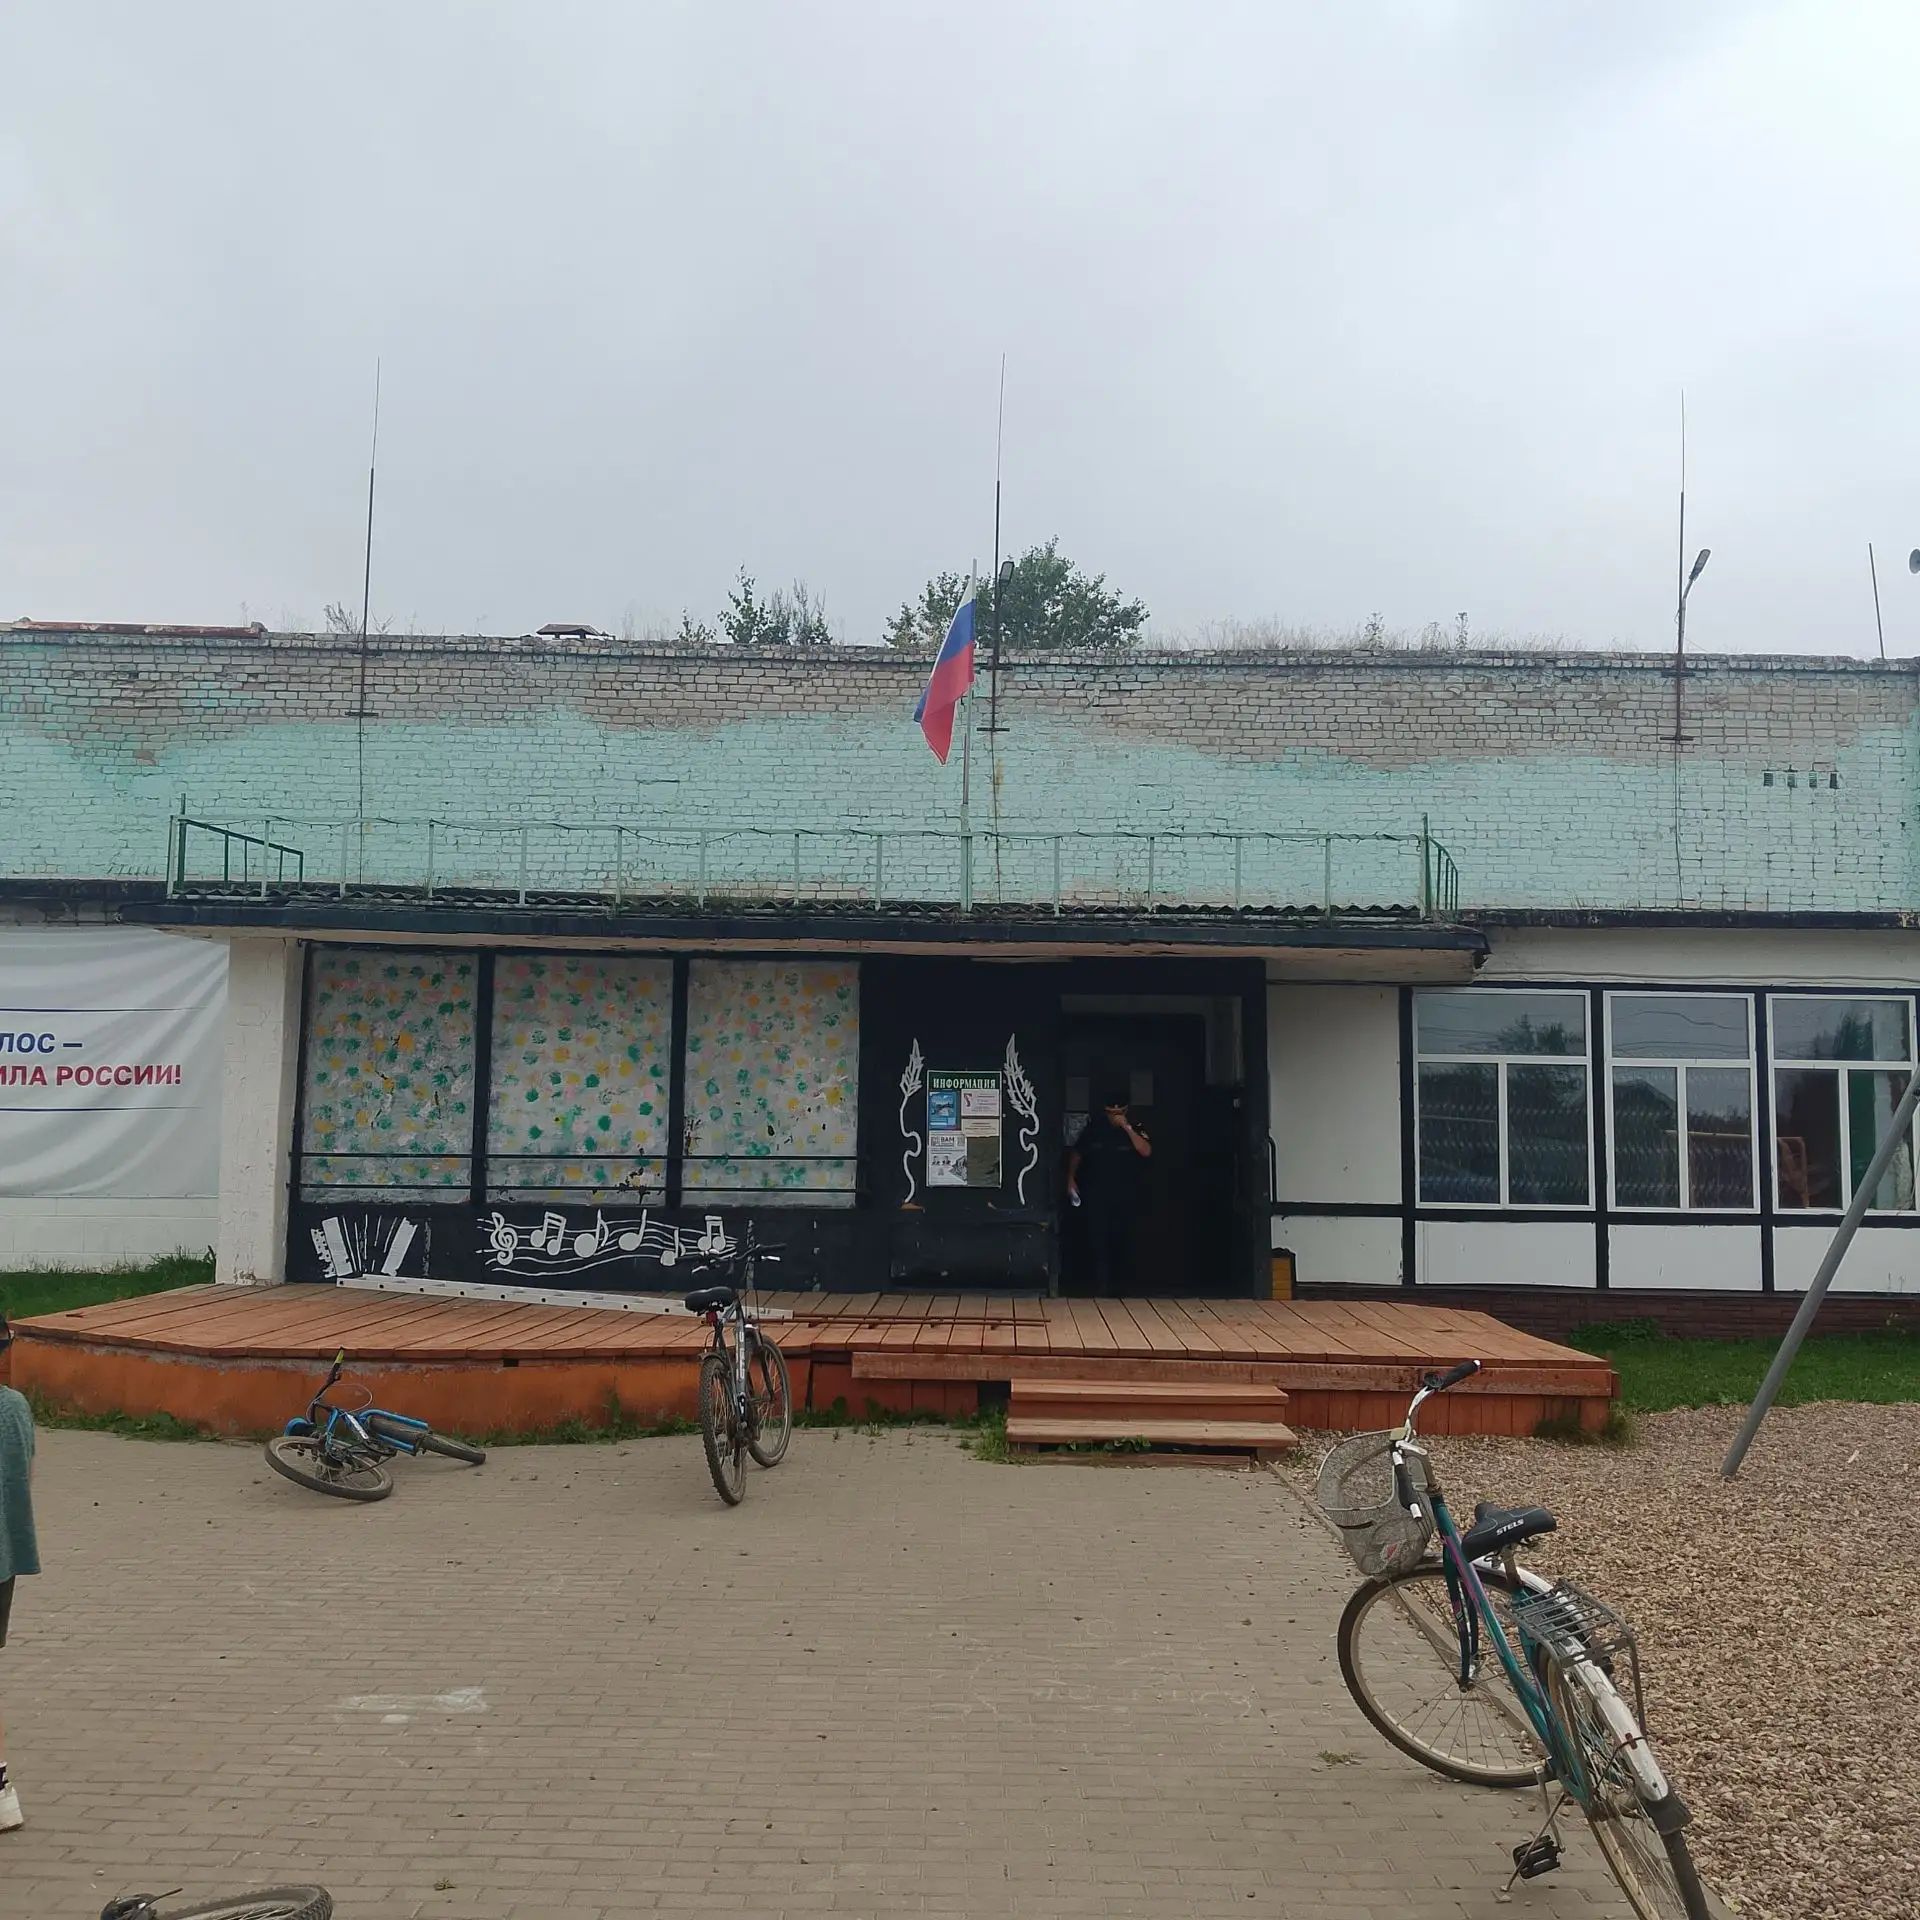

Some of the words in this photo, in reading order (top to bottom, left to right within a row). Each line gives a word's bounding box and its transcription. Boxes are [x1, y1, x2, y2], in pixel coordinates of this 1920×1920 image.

[56, 1064, 182, 1086] РОССИИ!
[933, 1078, 996, 1089] ИНФОРМАЦИЯ
[1496, 1518, 1524, 1536] STELS
